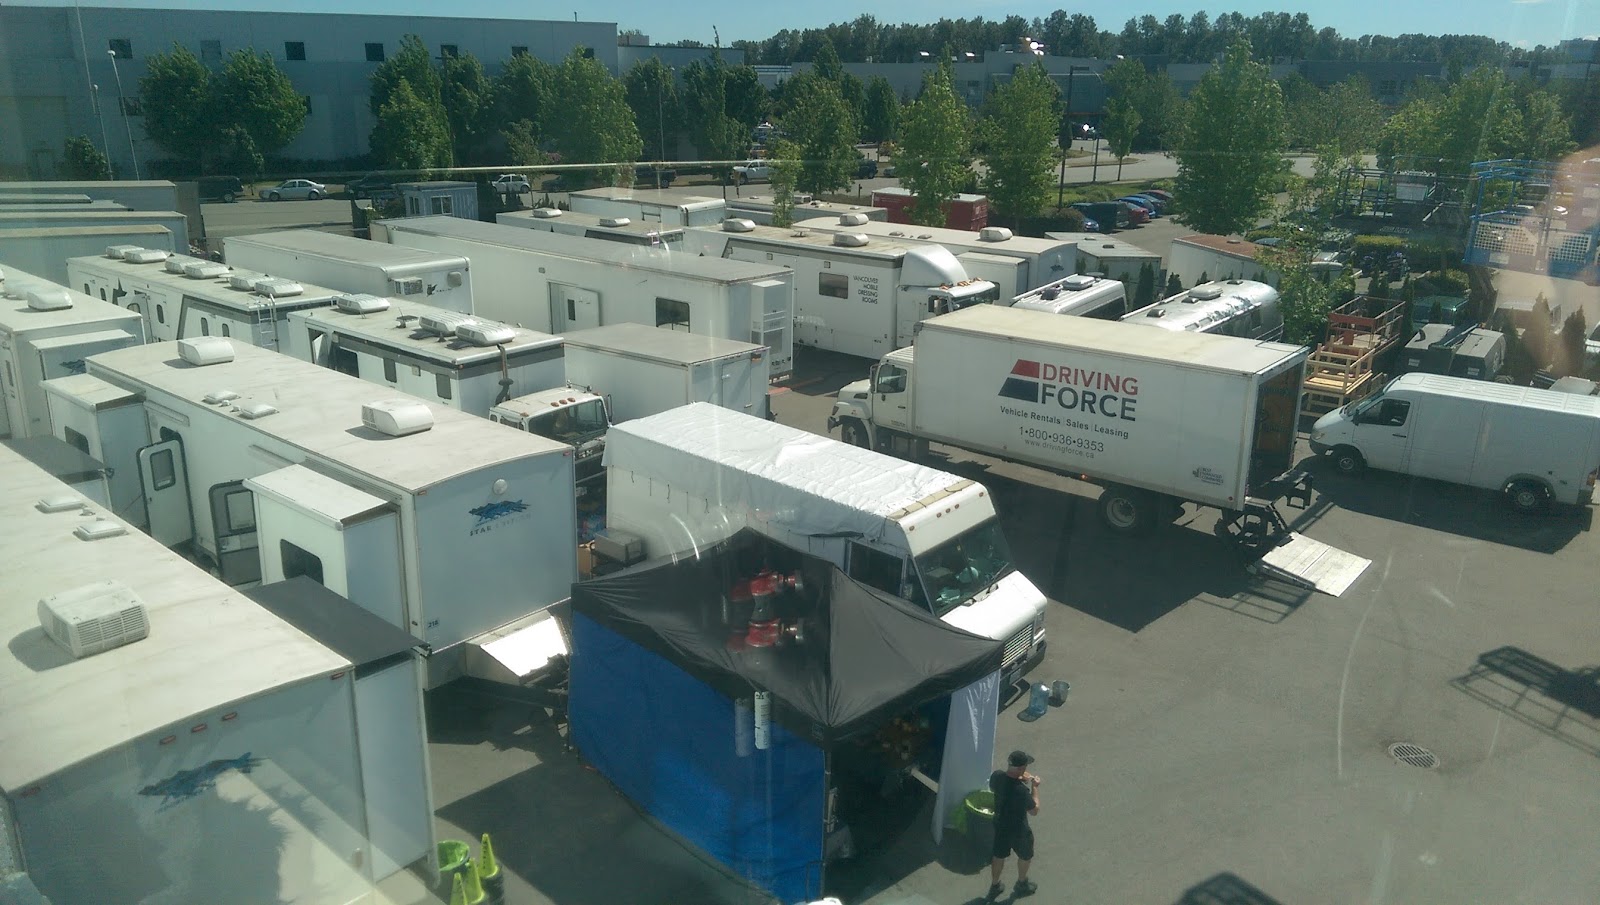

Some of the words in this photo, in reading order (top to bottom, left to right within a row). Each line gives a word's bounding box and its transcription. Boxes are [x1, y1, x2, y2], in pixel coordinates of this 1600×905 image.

[1042, 363, 1139, 396] DRIVING
[1041, 383, 1138, 422] FORCE
[1000, 405, 1029, 419] Vehicle
[1030, 411, 1061, 425] Rentals
[1066, 418, 1089, 431] Sales
[1094, 424, 1129, 440] Leasing
[1024, 438, 1095, 459] www.drivingforce.ca
